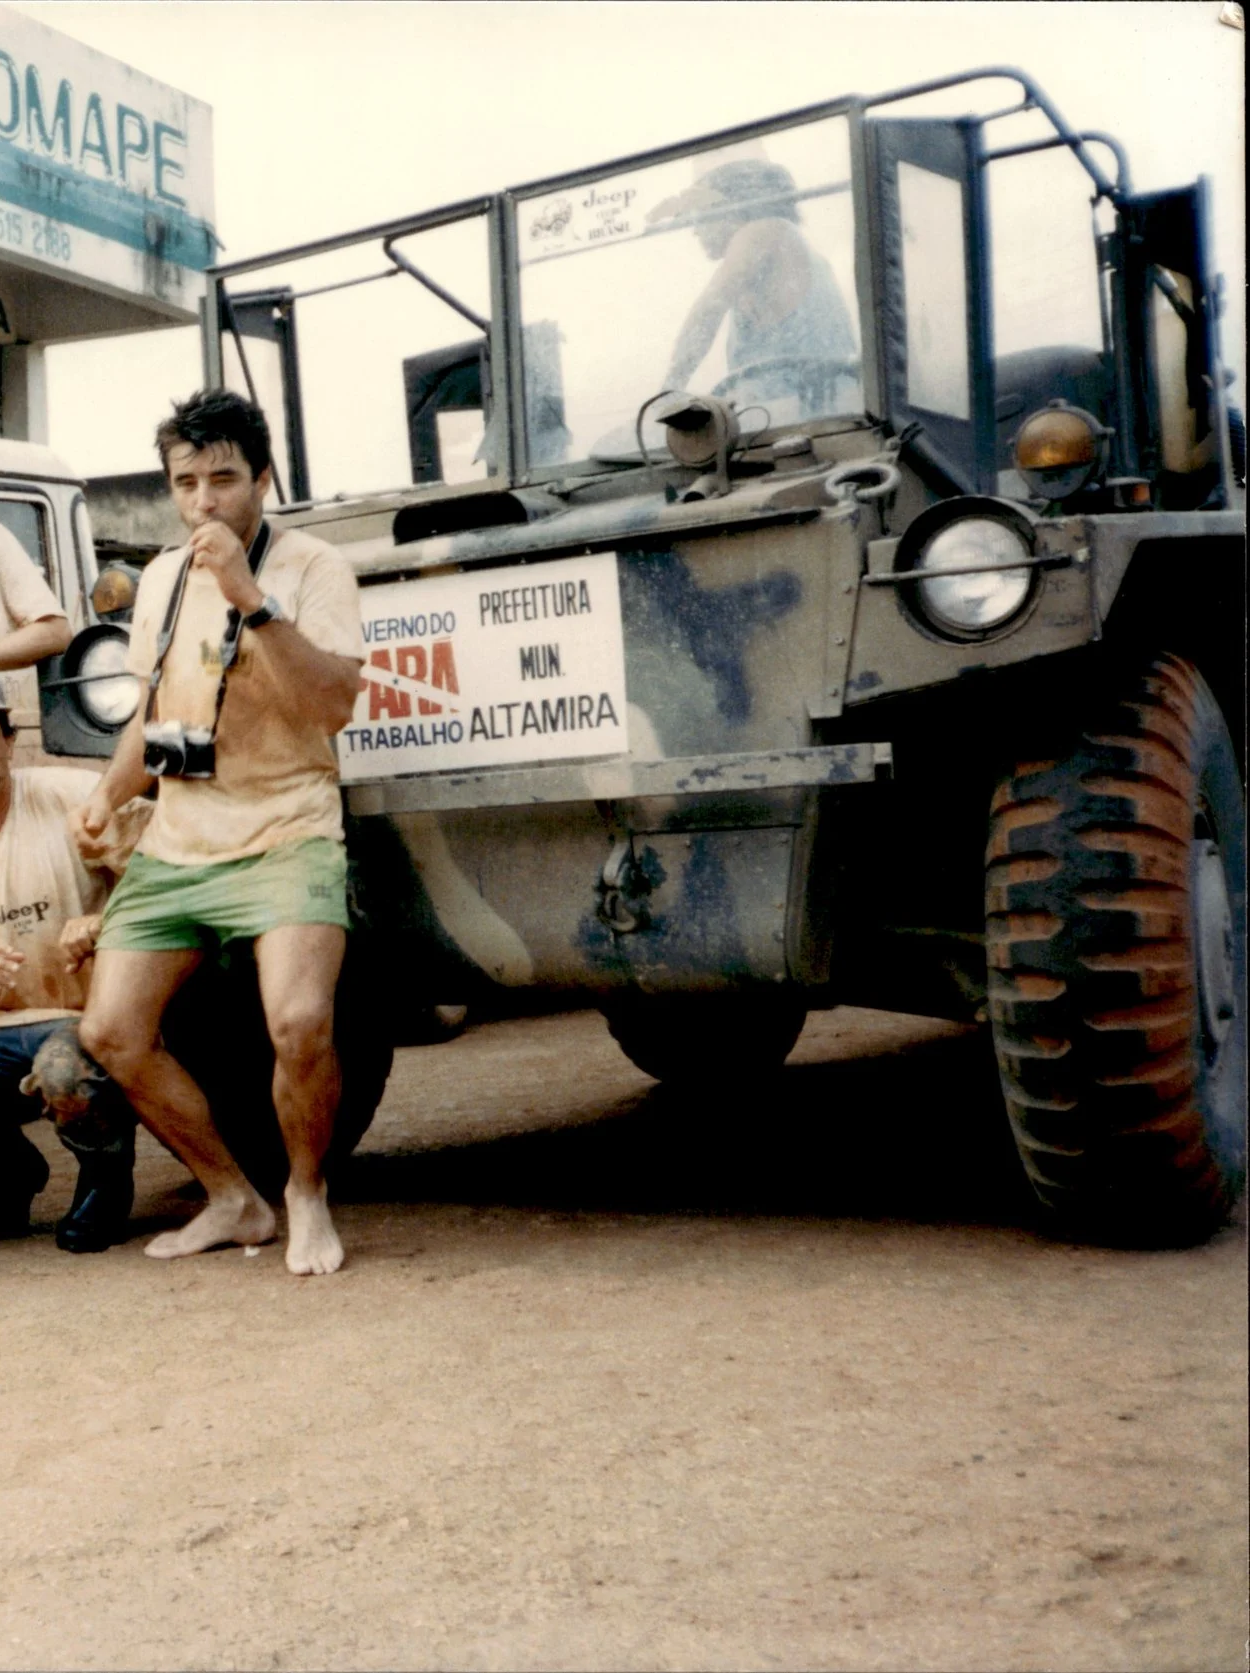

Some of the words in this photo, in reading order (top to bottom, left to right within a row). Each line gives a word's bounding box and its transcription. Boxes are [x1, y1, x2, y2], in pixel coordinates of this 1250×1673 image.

[478, 579, 593, 627] PREFEITURA
[360, 614, 428, 644] VERNO
[344, 719, 464, 752] TRABALHO
[469, 691, 620, 743] ALTAMIRA
